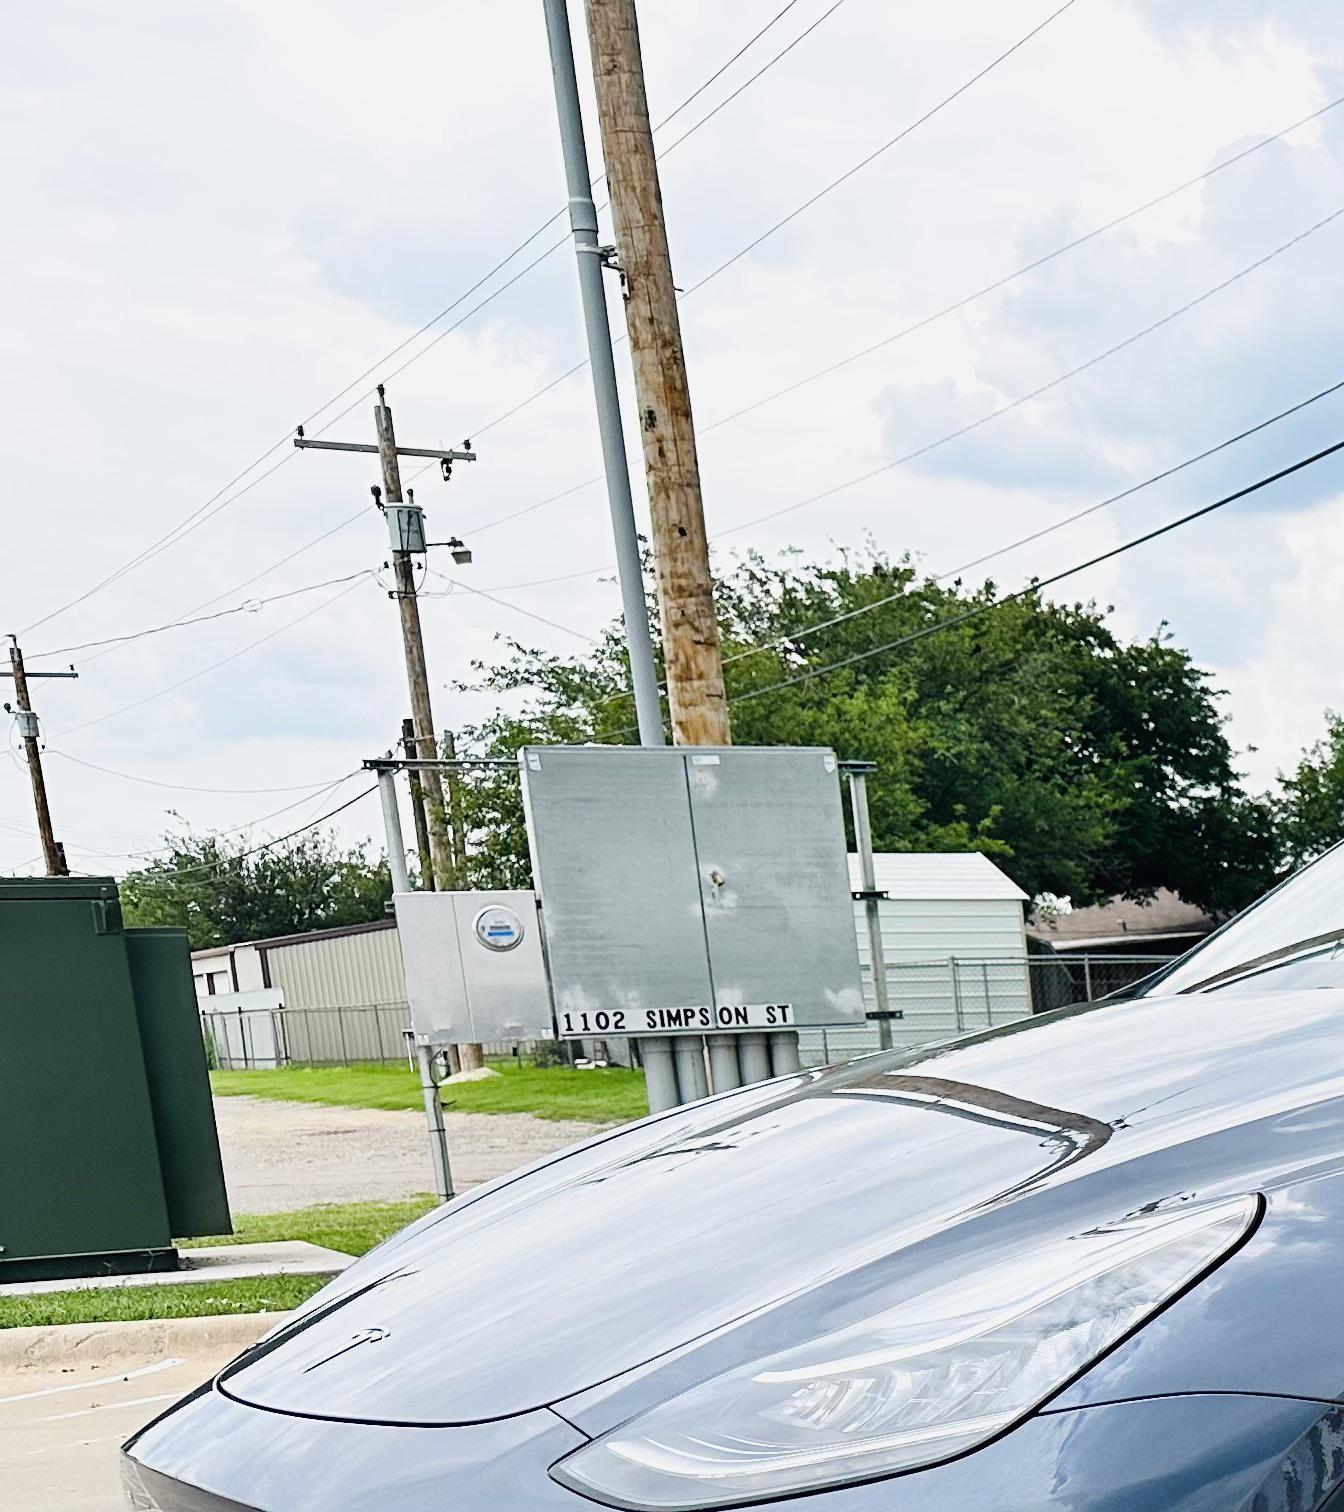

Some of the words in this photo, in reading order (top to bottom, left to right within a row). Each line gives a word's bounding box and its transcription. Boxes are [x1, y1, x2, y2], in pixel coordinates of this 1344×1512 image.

[563, 1010, 626, 1032] 1102
[646, 1006, 749, 1029] SIMPSON
[765, 1004, 790, 1025] ST
